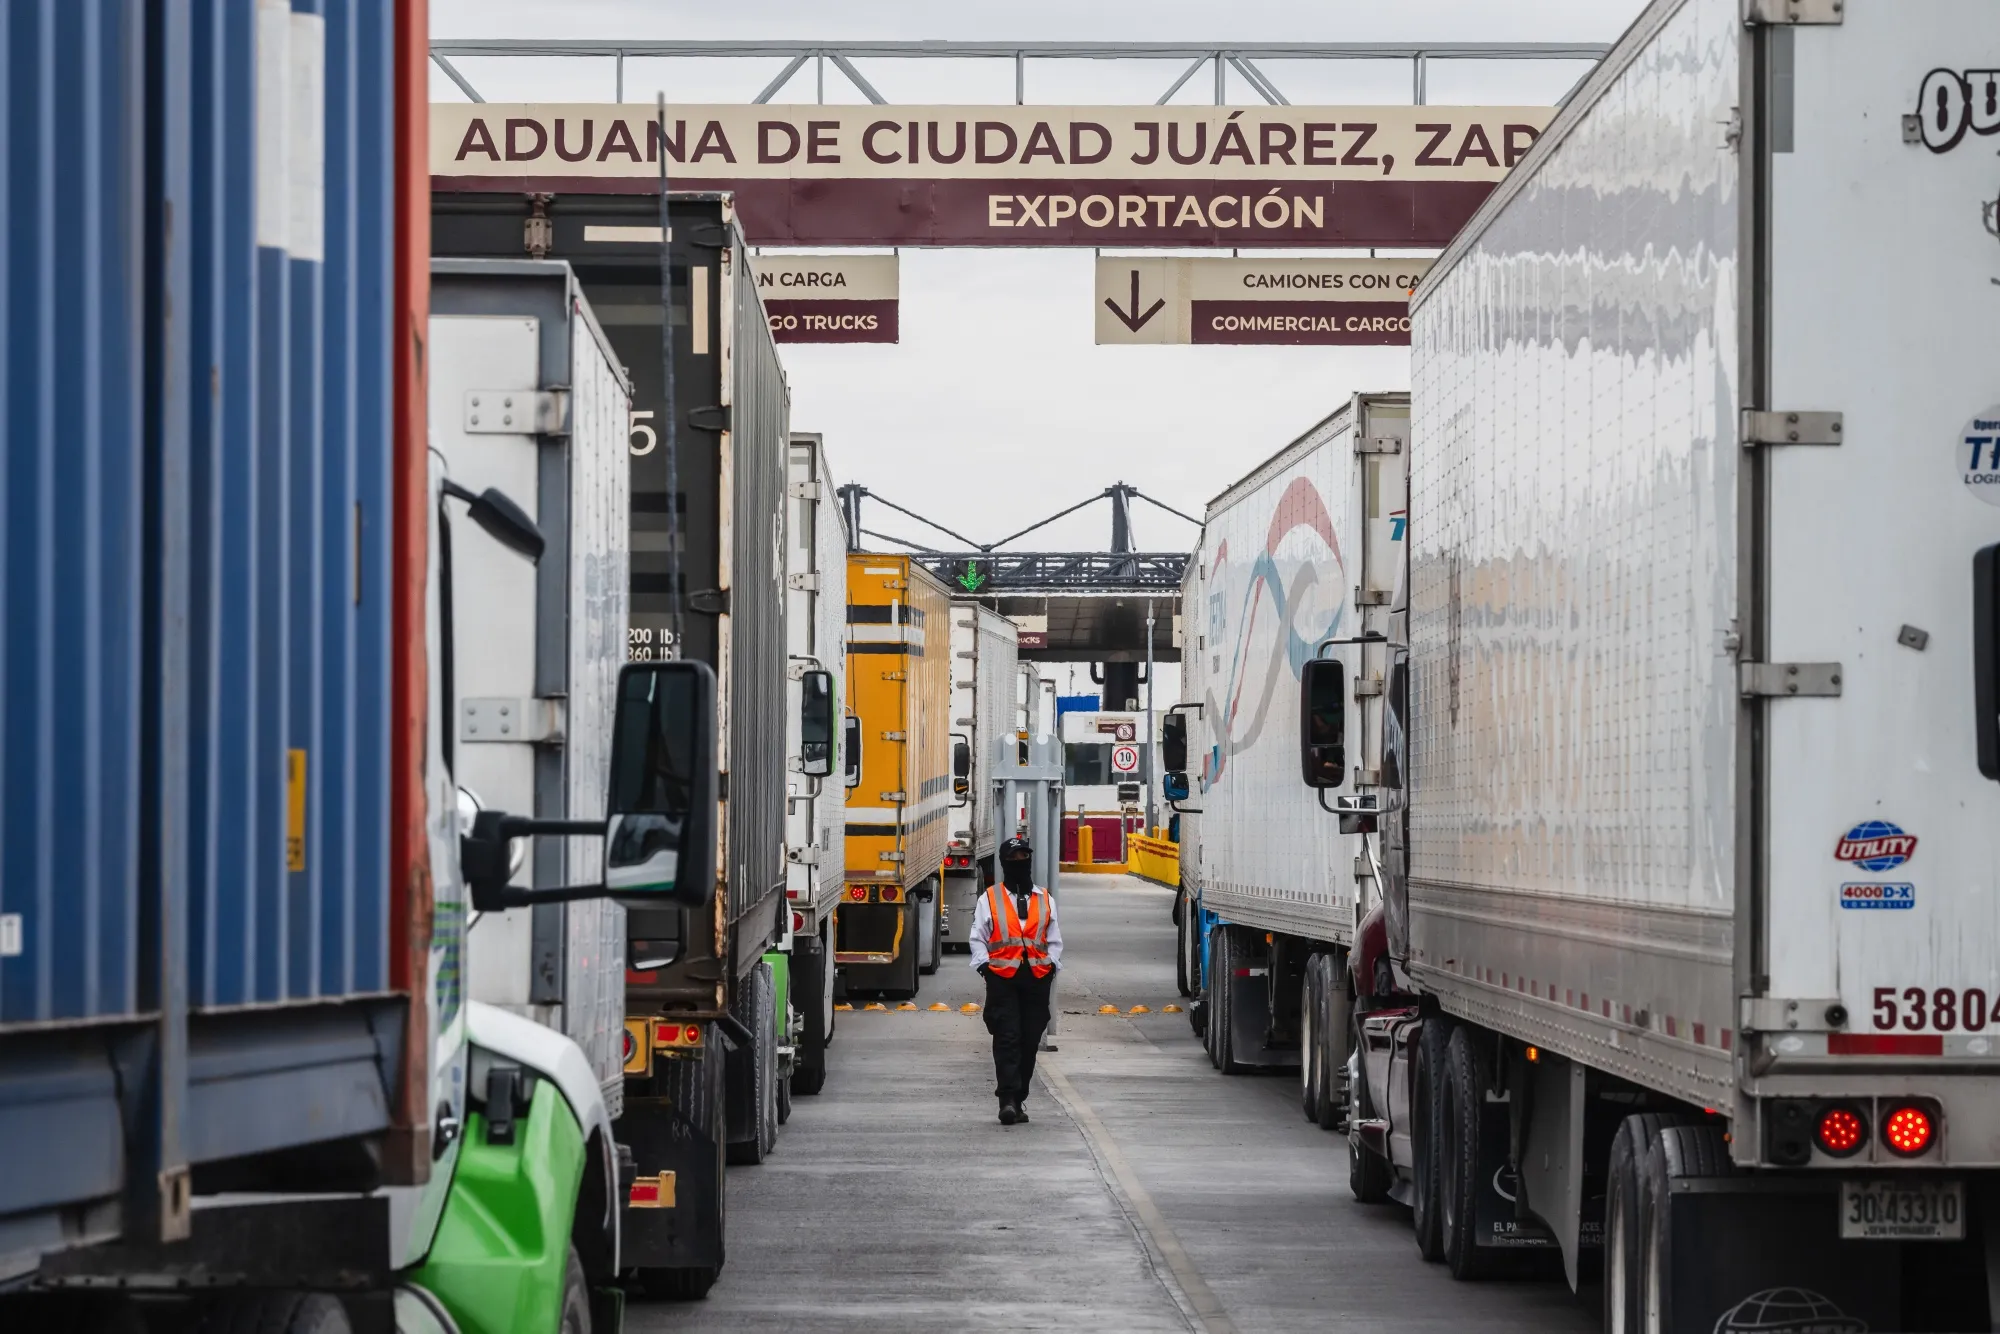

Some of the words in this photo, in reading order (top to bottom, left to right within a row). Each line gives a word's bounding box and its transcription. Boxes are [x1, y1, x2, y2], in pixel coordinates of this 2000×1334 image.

[454, 118, 737, 165] ADUANA
[758, 120, 842, 165] DE
[861, 120, 1113, 165] CIUDAD
[1130, 111, 1395, 176] JUÁREZ,
[988, 187, 1325, 228] EXPORTACIÓN
[757, 272, 774, 287] N
[779, 272, 847, 287] CARGA
[1243, 274, 1344, 289] CAMIONES
[1349, 274, 1391, 289] CON
[768, 315, 798, 331] GO
[803, 315, 879, 331] TRUCKS
[1212, 315, 1341, 332] COMMERCIAL
[1345, 317, 1412, 332] CARGO
[1120, 751, 1132, 763] 10
[1839, 838, 1913, 859] UTILITY
[1844, 885, 1910, 899] 4000D-X
[1493, 1222, 1505, 1232] EL
